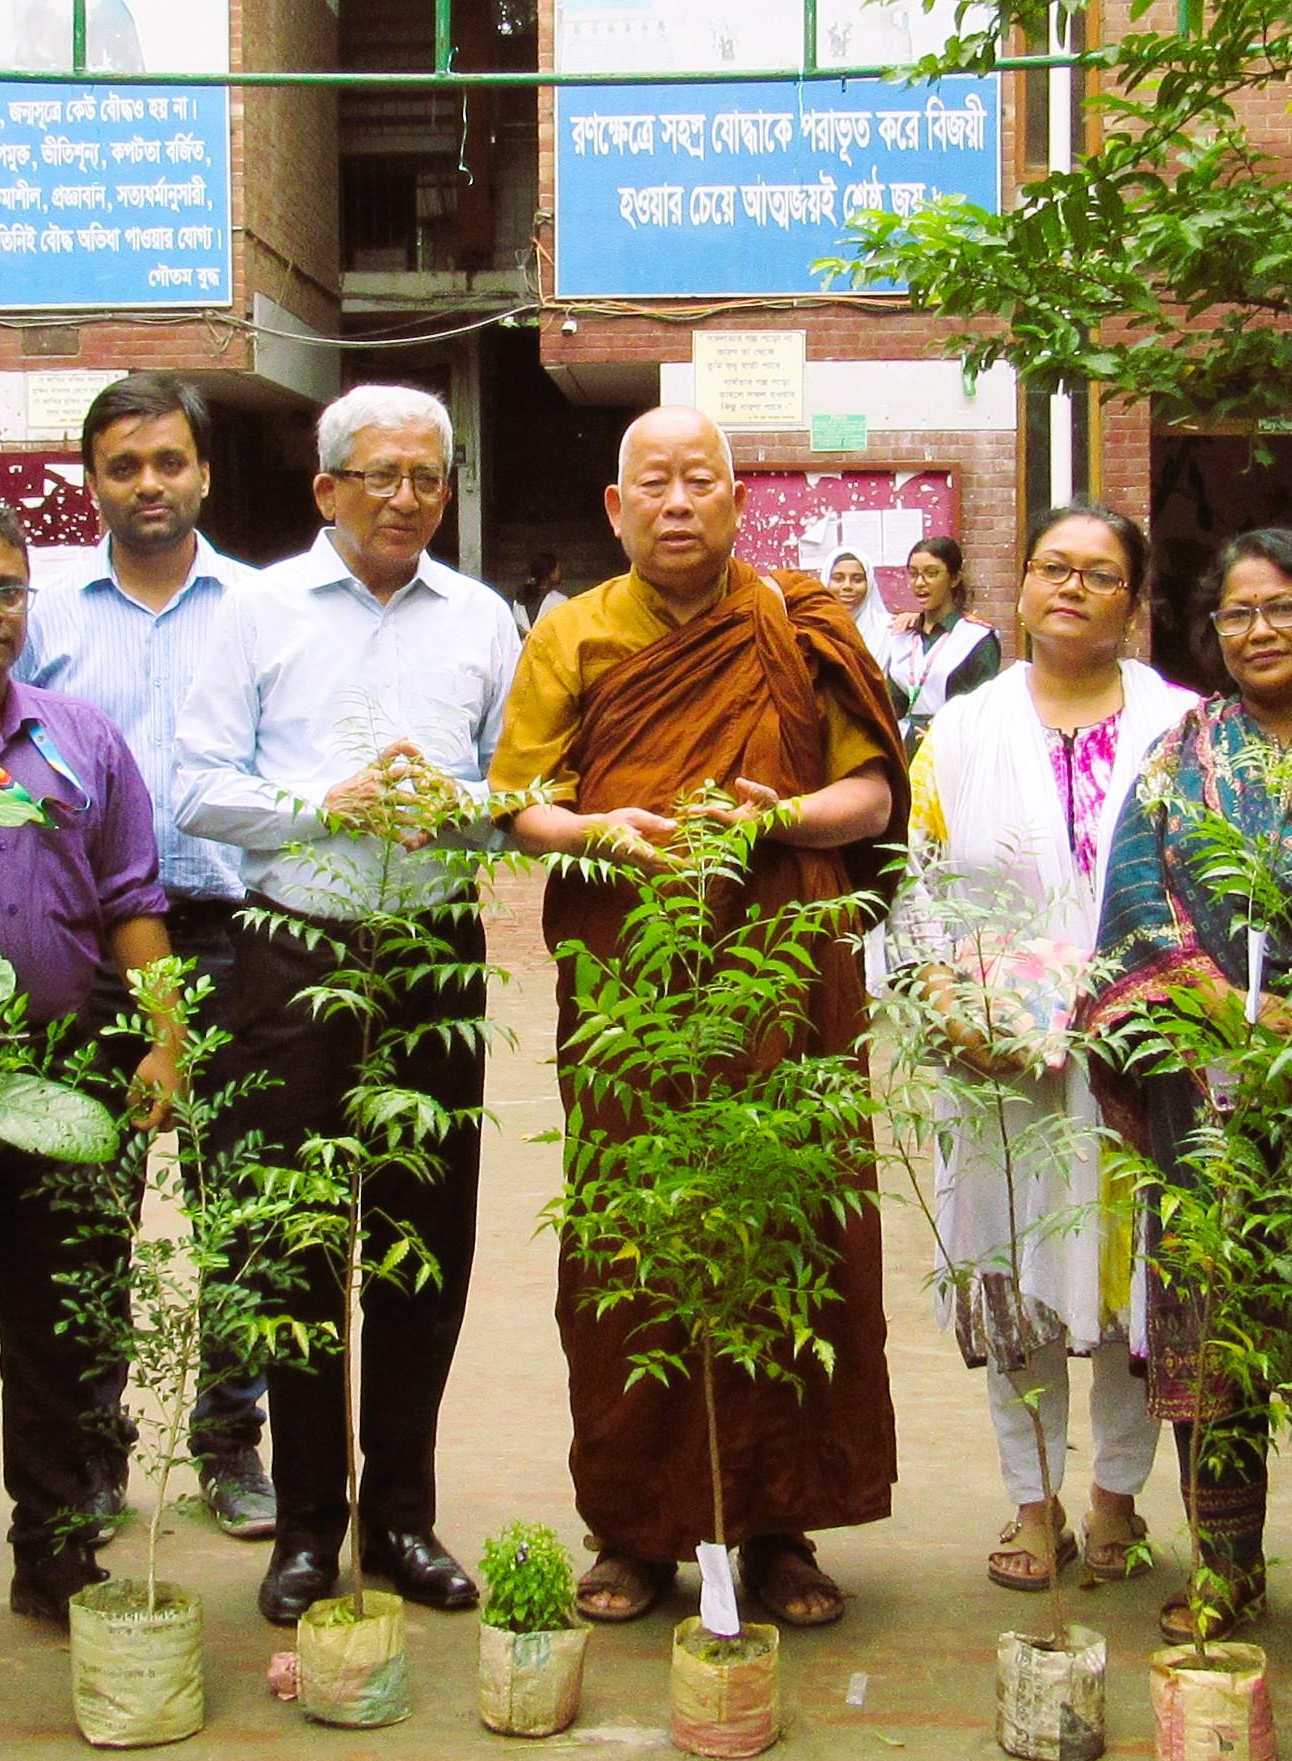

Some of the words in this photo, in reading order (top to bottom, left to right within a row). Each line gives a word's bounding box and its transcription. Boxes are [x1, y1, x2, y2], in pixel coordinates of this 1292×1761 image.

[66, 92, 97, 122] কেউ
[100, 91, 144, 122] বৌদ্ধও
[148, 97, 169, 122] হয়
[569, 112, 656, 156] রণক্ষেত্রে
[659, 113, 707, 161] সহস্র
[711, 109, 794, 155] যোদ্ধাকে
[800, 108, 872, 166] পরাভূত
[875, 110, 921, 151] করে
[925, 92, 988, 152] বিজয়ী
[109, 135, 162, 165] কপটতা
[617, 183, 685, 230] হওয়ার
[689, 184, 737, 227] চেয়ে
[740, 170, 838, 231] আত্মজয়ই
[40, 222, 75, 254] বৌদ্ধ
[76, 221, 121, 252] অভিধা
[124, 226, 174, 251] পাওয়ার
[147, 263, 193, 288] গৌতম
[195, 266, 221, 291] বুদ্ধ
